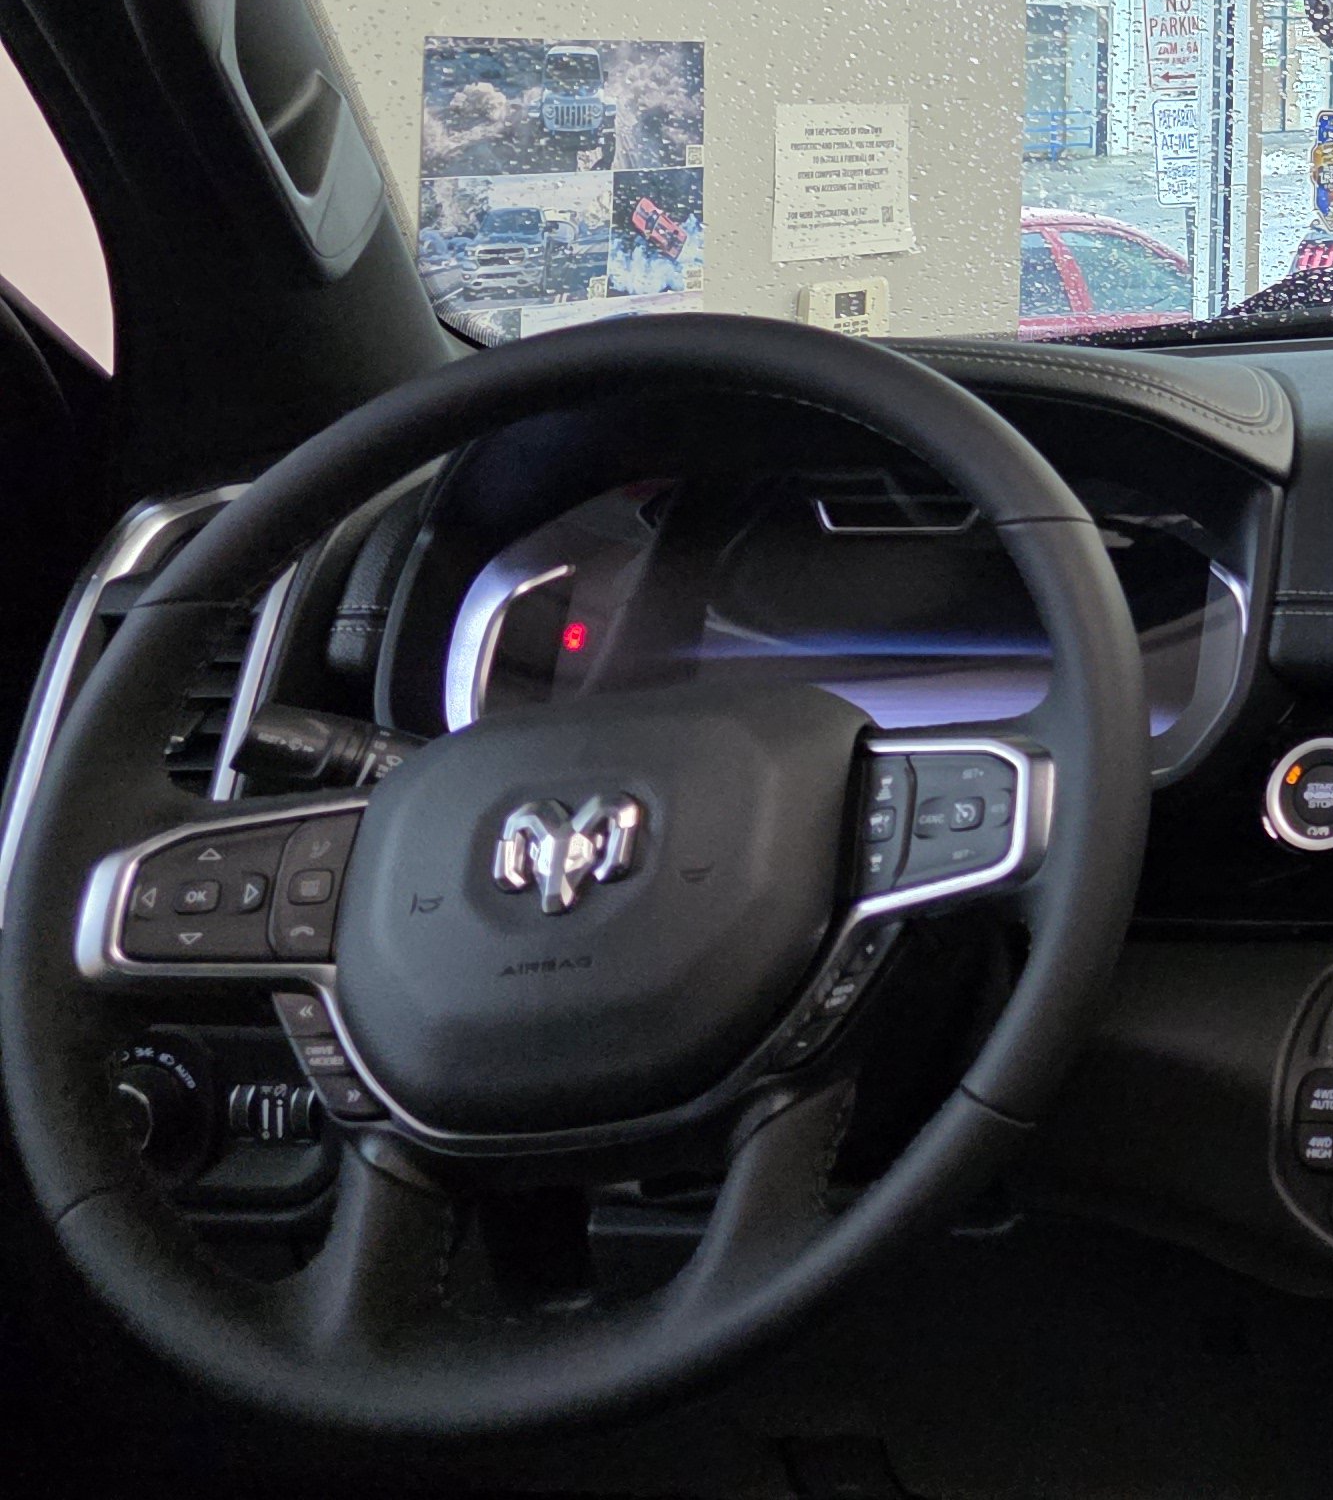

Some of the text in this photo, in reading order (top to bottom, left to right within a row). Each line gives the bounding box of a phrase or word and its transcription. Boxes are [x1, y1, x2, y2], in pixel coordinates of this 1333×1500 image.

[1149, 15, 1199, 37] PARKIN
[184, 889, 207, 904] OK
[1308, 1136, 1333, 1148] 4WD
[1306, 1148, 1333, 1159] HIGH
